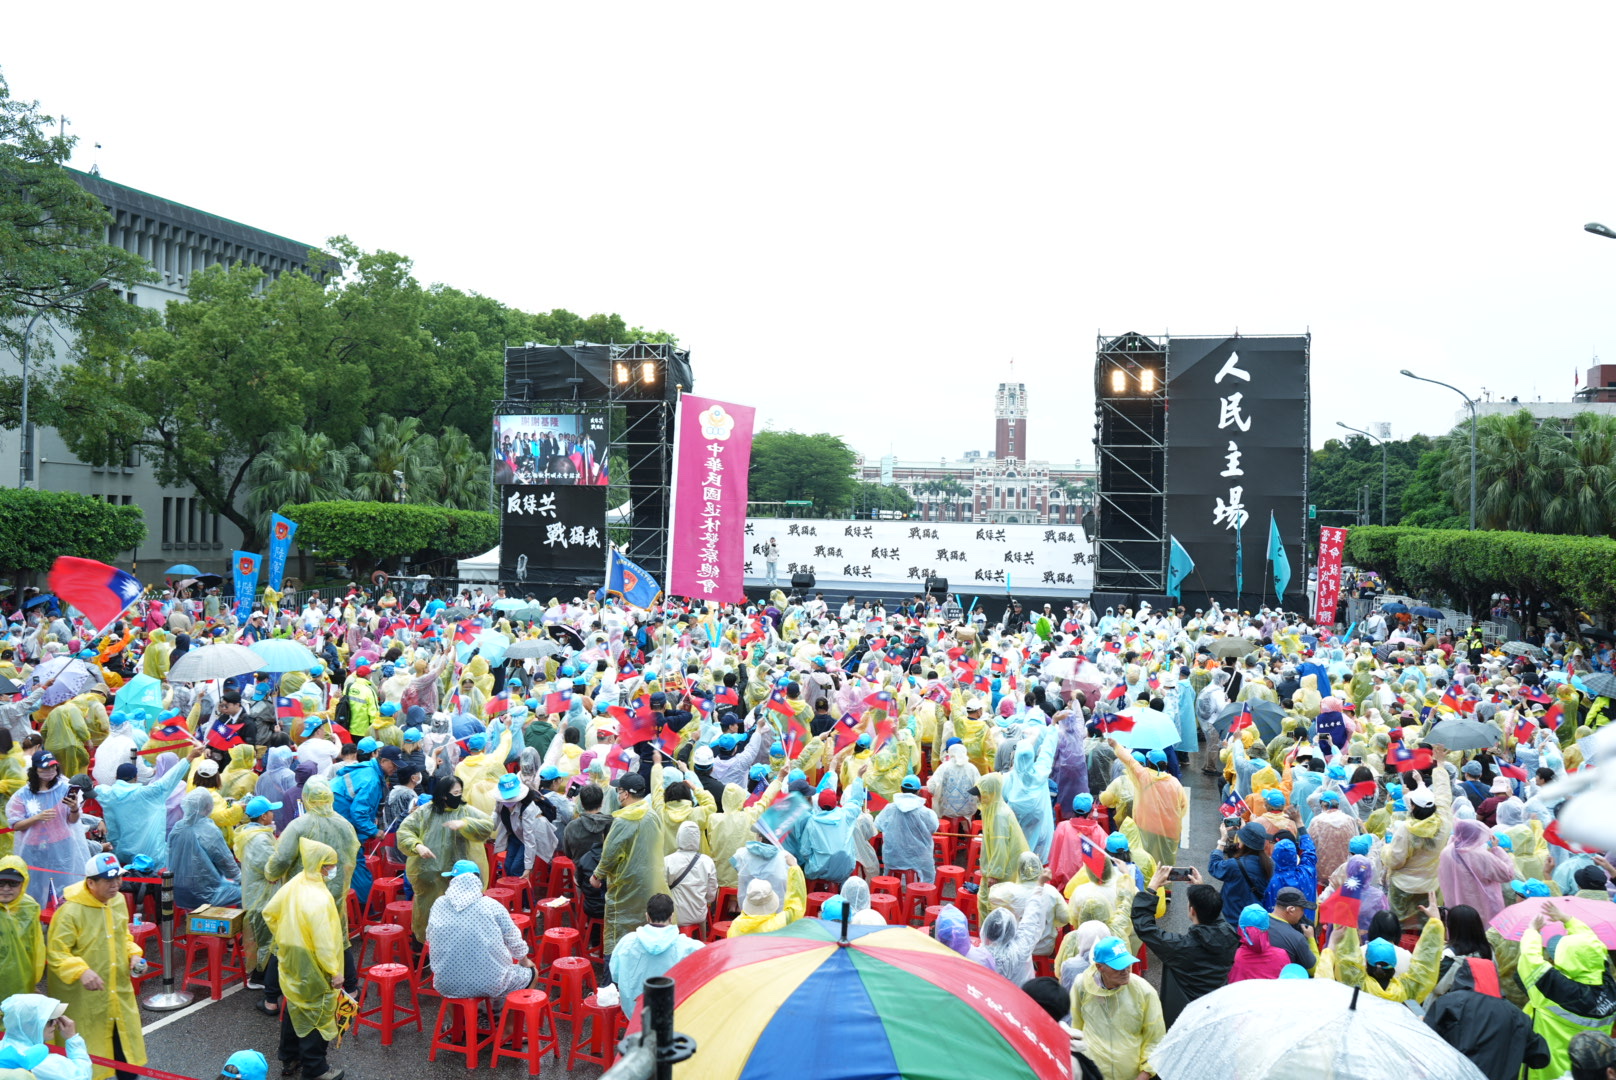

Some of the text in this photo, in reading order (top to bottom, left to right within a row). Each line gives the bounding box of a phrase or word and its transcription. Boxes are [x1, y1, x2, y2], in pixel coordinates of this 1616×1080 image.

[1213, 351, 1251, 530] 人民主場
[507, 491, 557, 518] 反綠共
[543, 521, 601, 549] 戰獨裁
[844, 525, 873, 539] 反綠共
[976, 528, 1006, 542] 反綠共
[871, 546, 900, 561] 反綠共
[1004, 550, 1034, 565] 反綠共
[843, 564, 872, 578] 反綠共
[975, 568, 1005, 583] 反綠共
